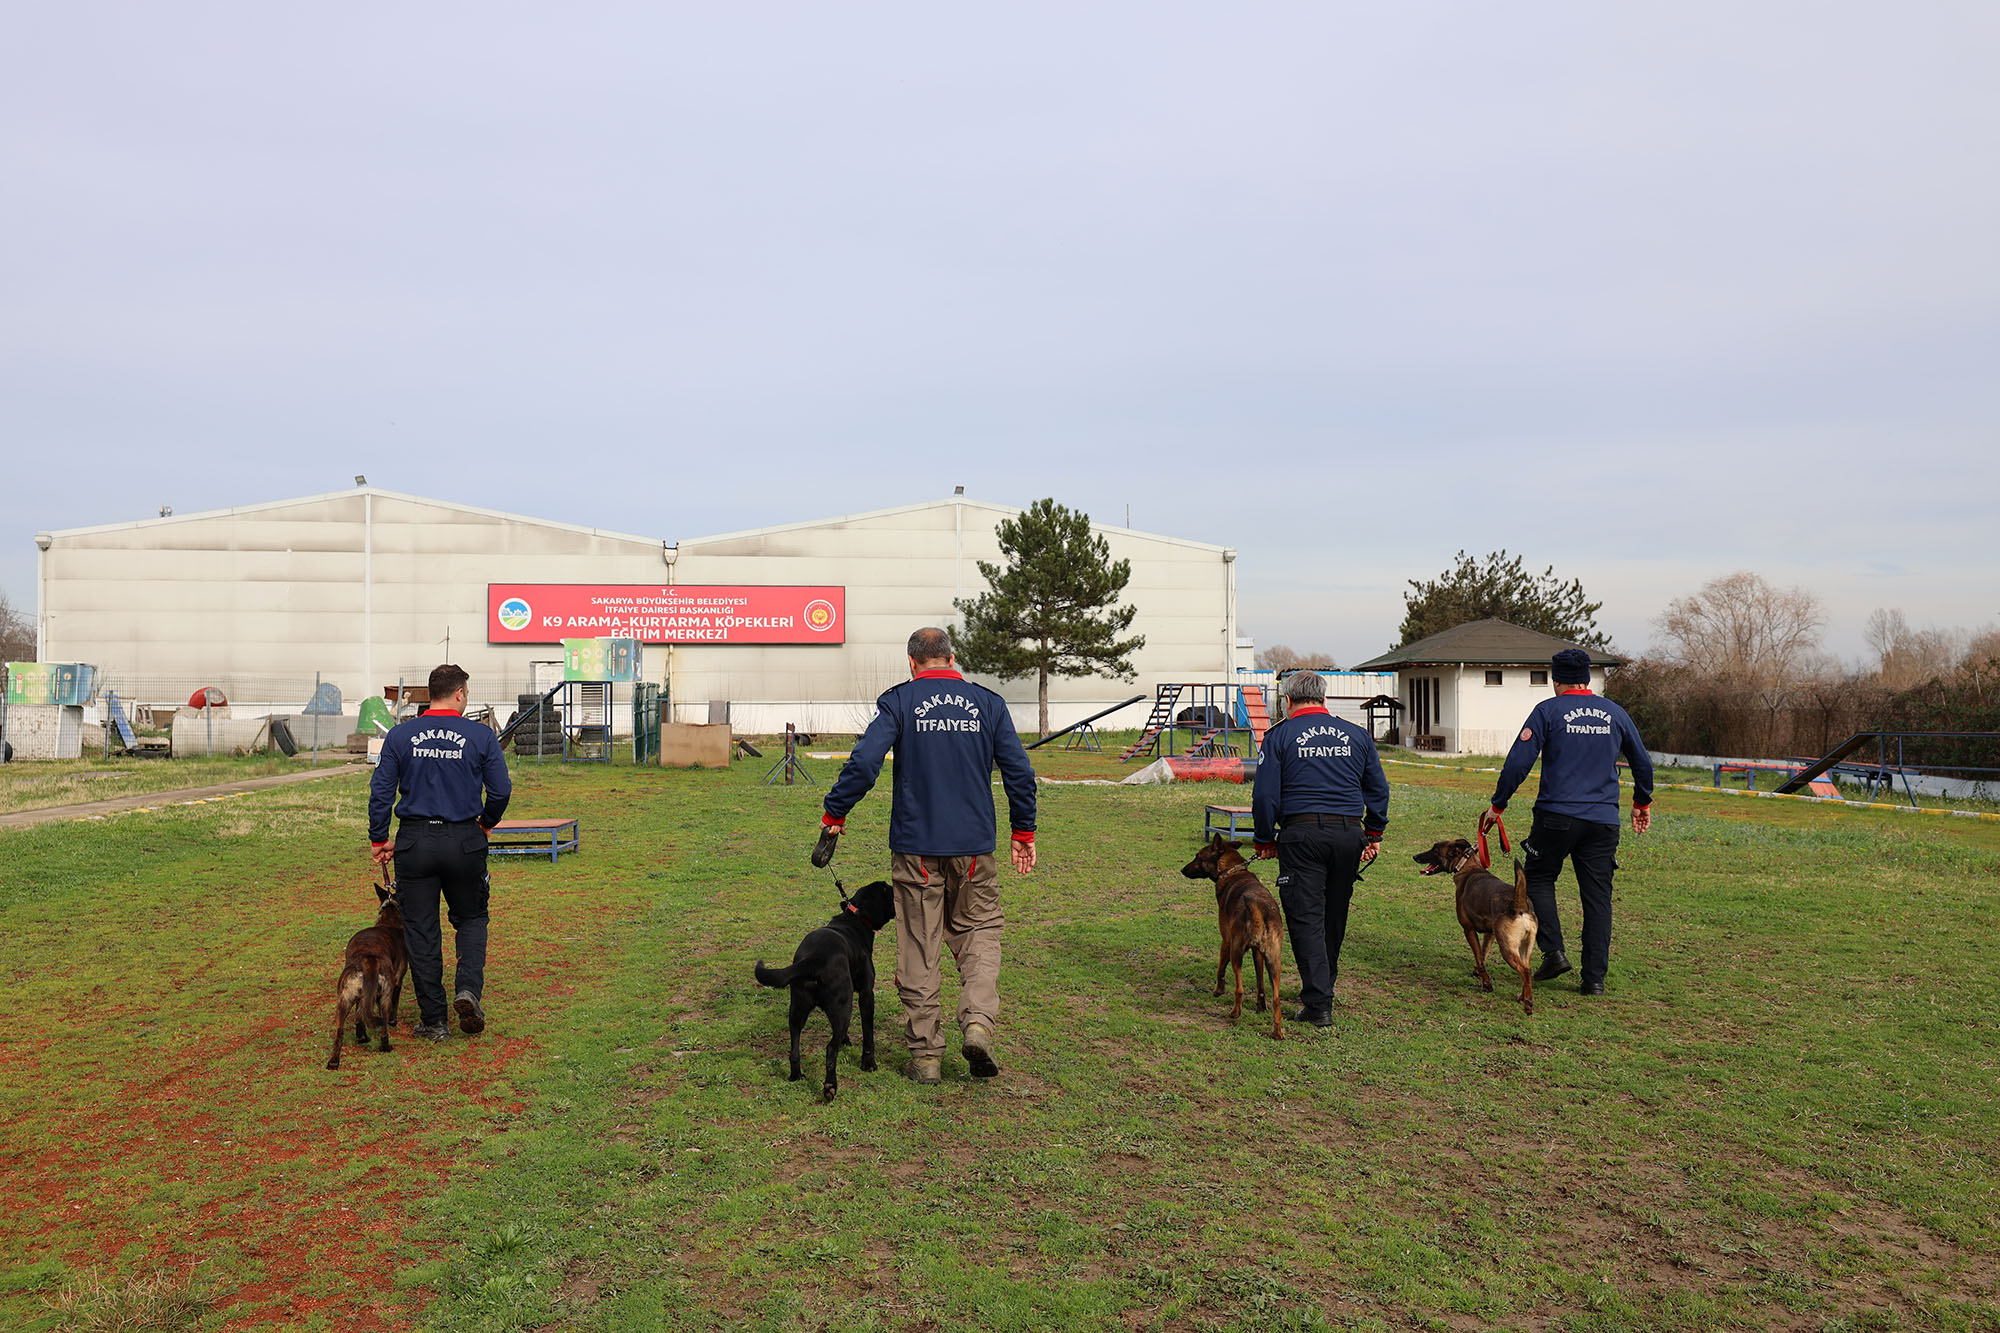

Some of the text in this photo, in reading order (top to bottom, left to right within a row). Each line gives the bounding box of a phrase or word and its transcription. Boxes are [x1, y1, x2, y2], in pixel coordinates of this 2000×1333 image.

[591, 597, 748, 606] SAKARYA BÜYÜKŞEHİR BELEDİYESİ
[605, 605, 734, 615] İTFAİYE DAİRESİ BAŞKANLIĞI
[543, 616, 563, 627] K9
[715, 615, 794, 628] KÖPEKLERİ
[611, 627, 728, 640] EĞİTİM MERKEZİ
[914, 693, 980, 719] SAKARYA
[1563, 707, 1612, 724] SAKARYA
[410, 729, 467, 748] SAKARYA
[1296, 725, 1350, 746] SAKARYA
